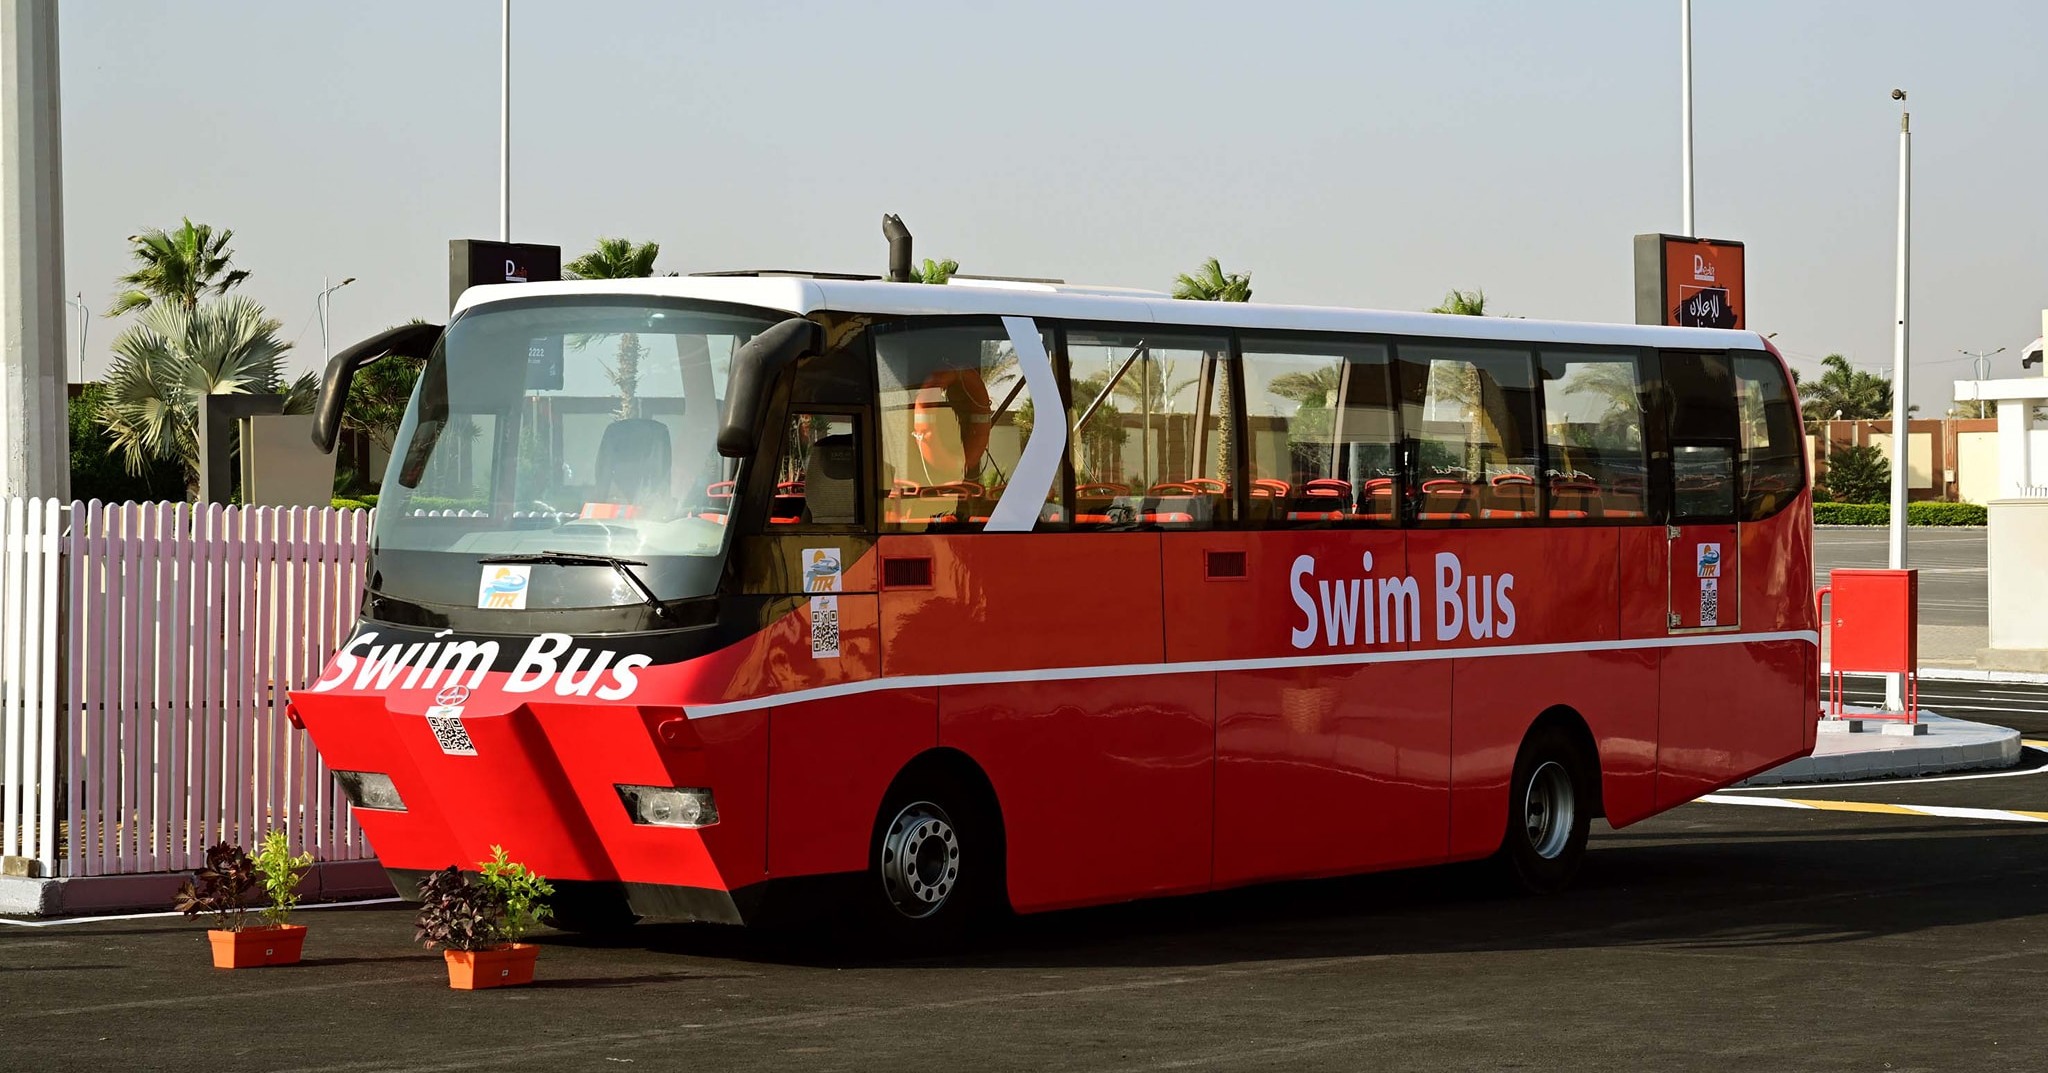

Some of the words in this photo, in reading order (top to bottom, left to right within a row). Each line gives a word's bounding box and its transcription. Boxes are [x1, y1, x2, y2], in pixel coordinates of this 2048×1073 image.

[1290, 550, 1421, 649] Swim
[1435, 551, 1516, 641] Bus
[312, 629, 500, 693] Swim
[502, 632, 653, 701] Bus
